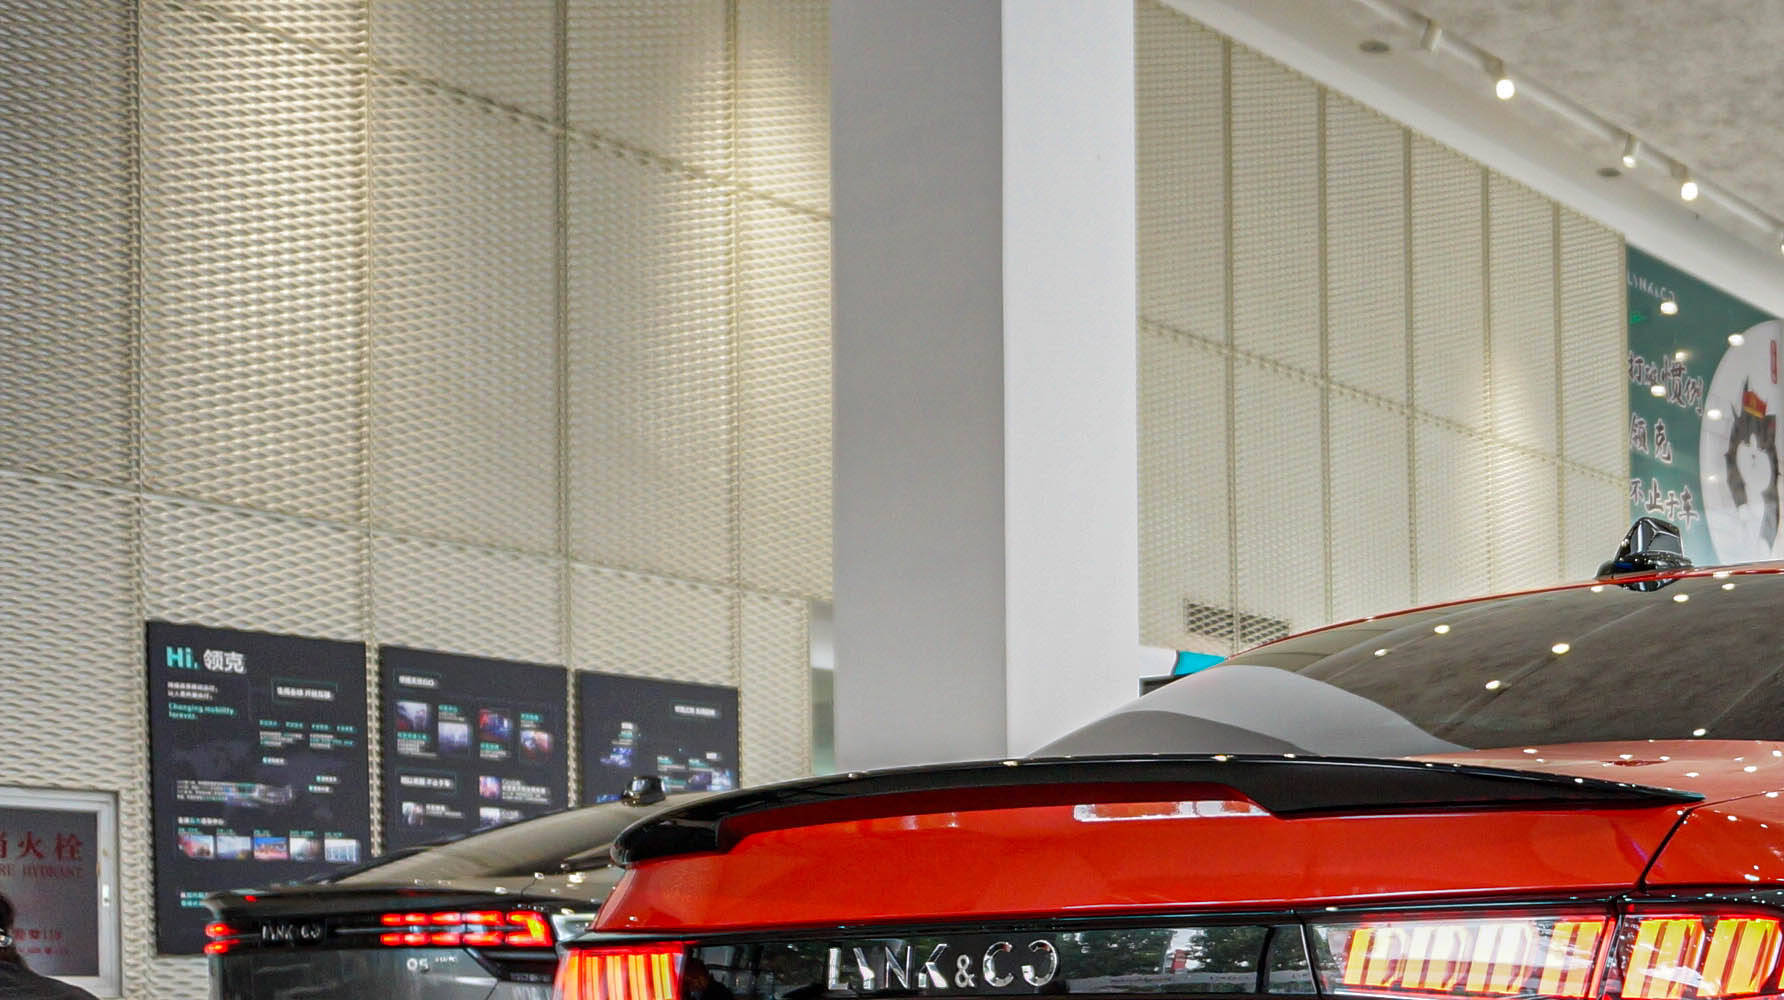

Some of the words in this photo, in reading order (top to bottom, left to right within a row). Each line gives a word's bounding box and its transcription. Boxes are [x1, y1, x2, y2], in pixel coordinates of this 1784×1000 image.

[1630, 412, 1673, 464] 领克
[1630, 477, 1699, 531] 不止于车
[166, 646, 198, 670] Hi.
[203, 649, 246, 674] 领克
[0, 830, 84, 862] 火栓
[827, 940, 1058, 991] LYNK&CO
